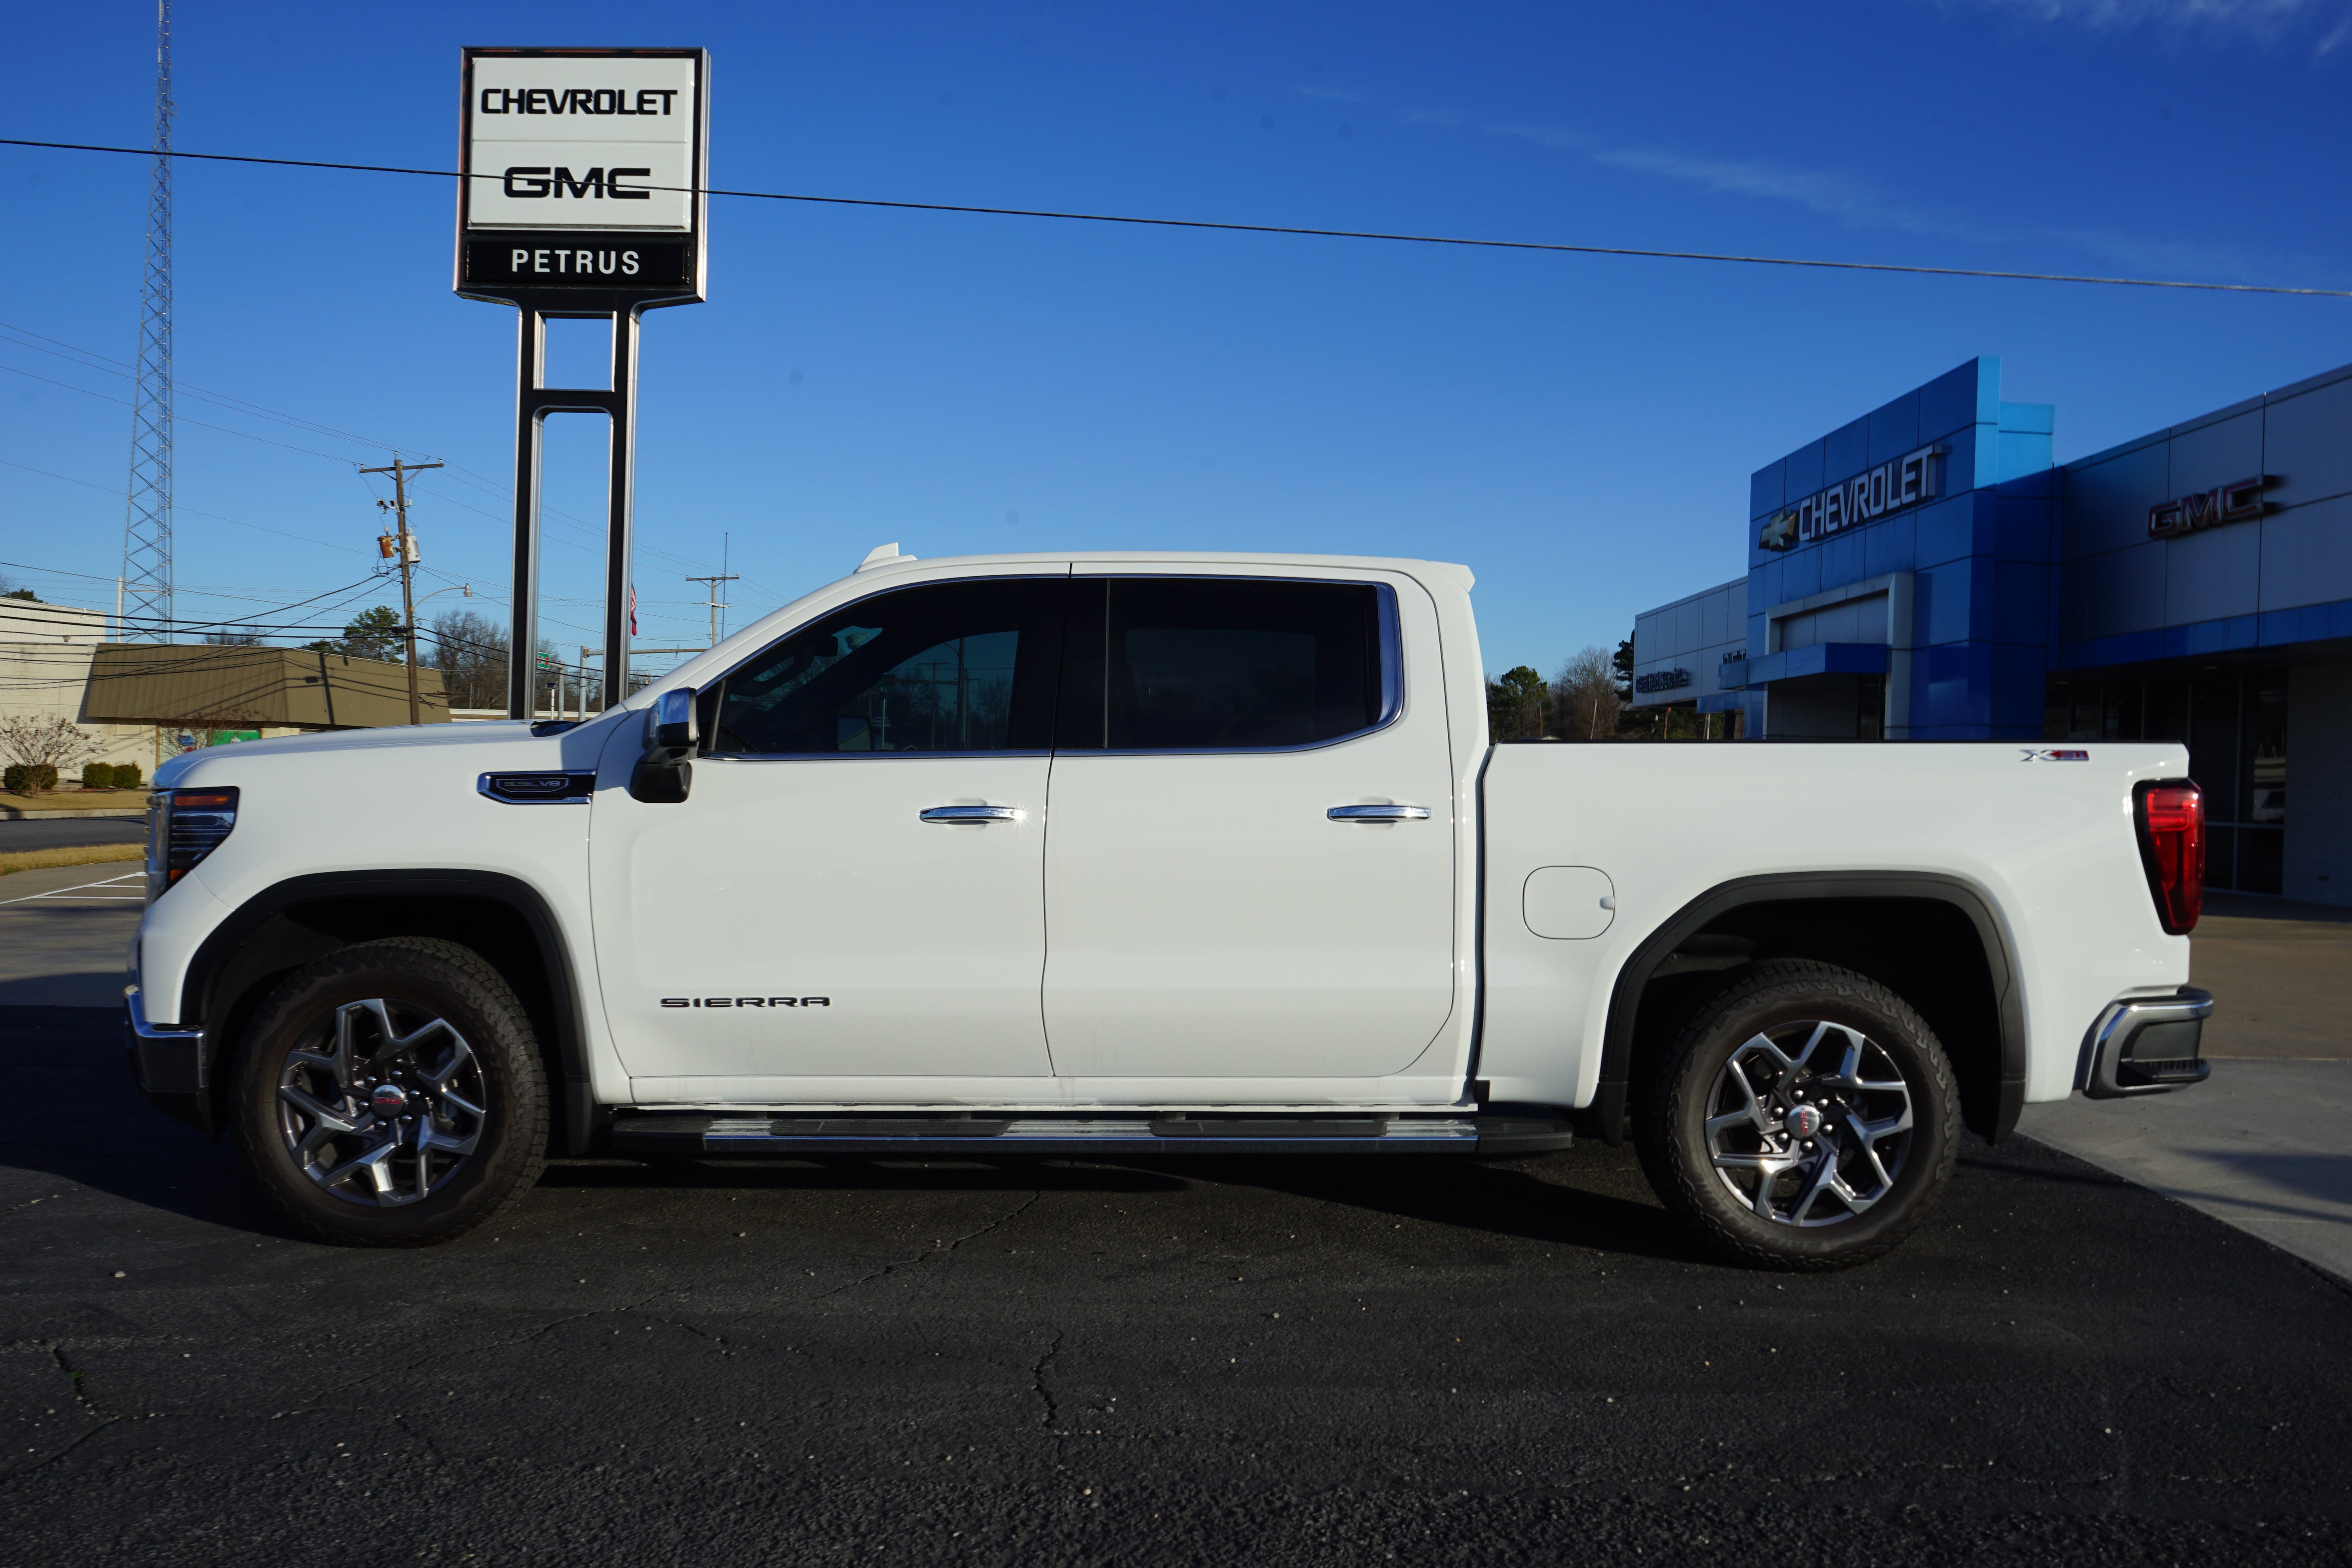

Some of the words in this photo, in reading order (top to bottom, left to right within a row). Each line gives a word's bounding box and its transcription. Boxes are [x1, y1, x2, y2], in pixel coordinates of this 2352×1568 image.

[481, 89, 678, 115] CHEVROLET
[504, 167, 651, 199] GMC
[512, 250, 640, 274] PETRUS
[1799, 445, 1936, 542] CHEVROLET
[2147, 475, 2263, 538] GMC
[661, 997, 830, 1008] SIERRA
